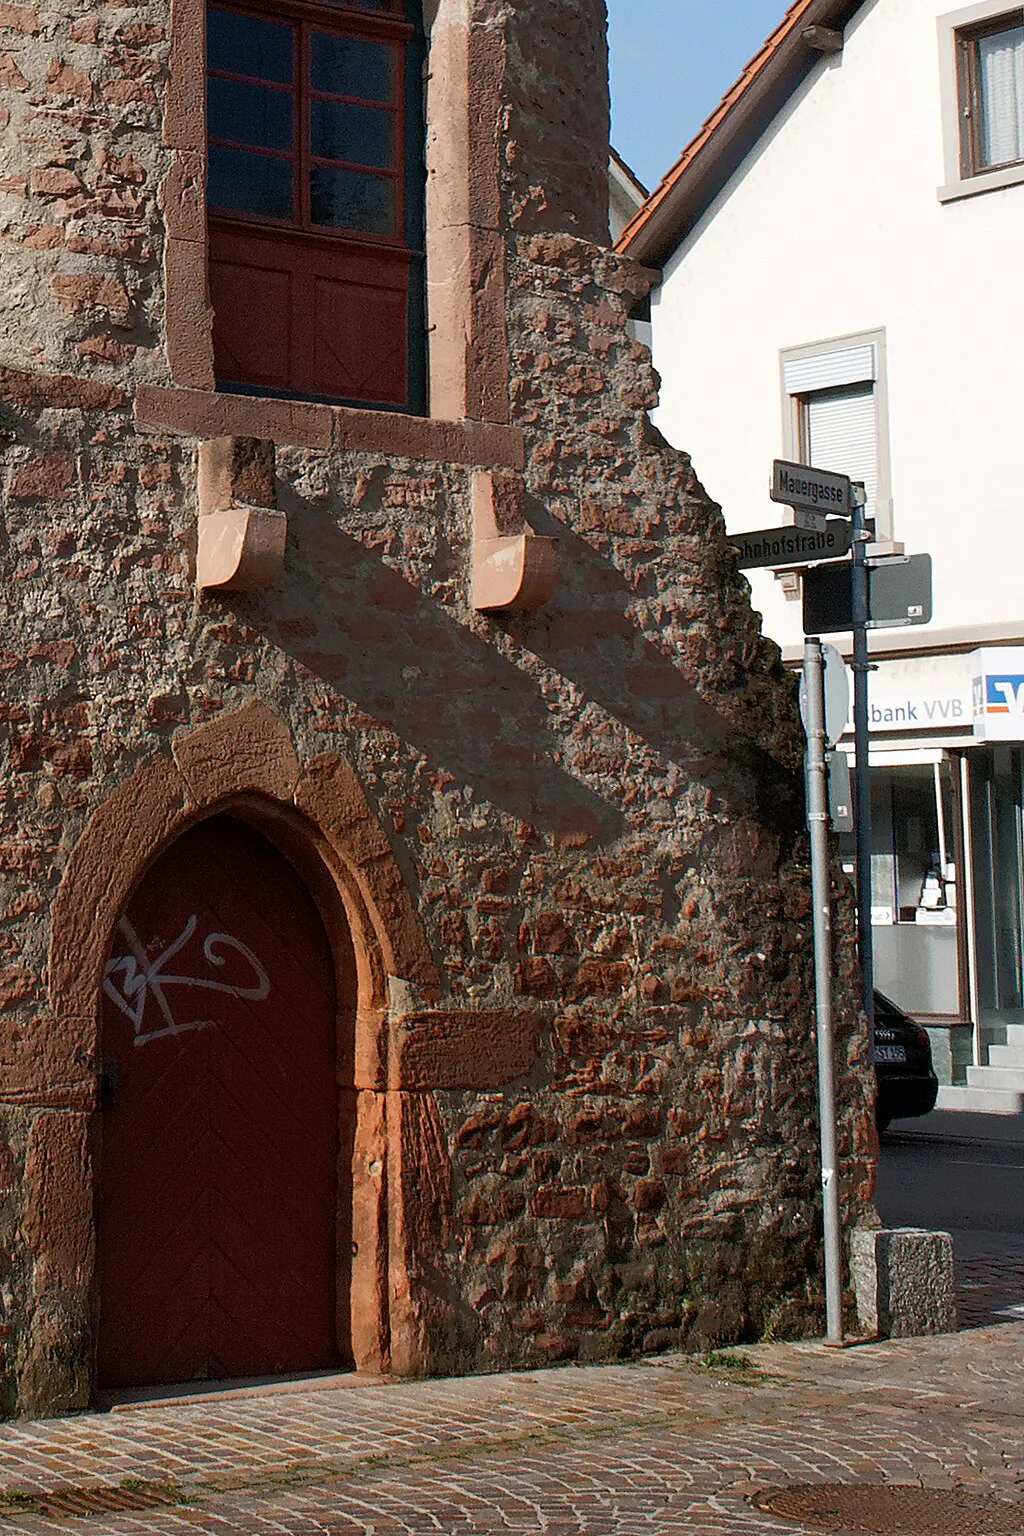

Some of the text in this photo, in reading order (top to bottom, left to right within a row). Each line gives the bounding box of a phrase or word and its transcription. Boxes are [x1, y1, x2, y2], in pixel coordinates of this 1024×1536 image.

[779, 470, 843, 503] Mauergasse
[738, 533, 835, 560] ahnhofstraße
[869, 698, 964, 723] bank VVB
